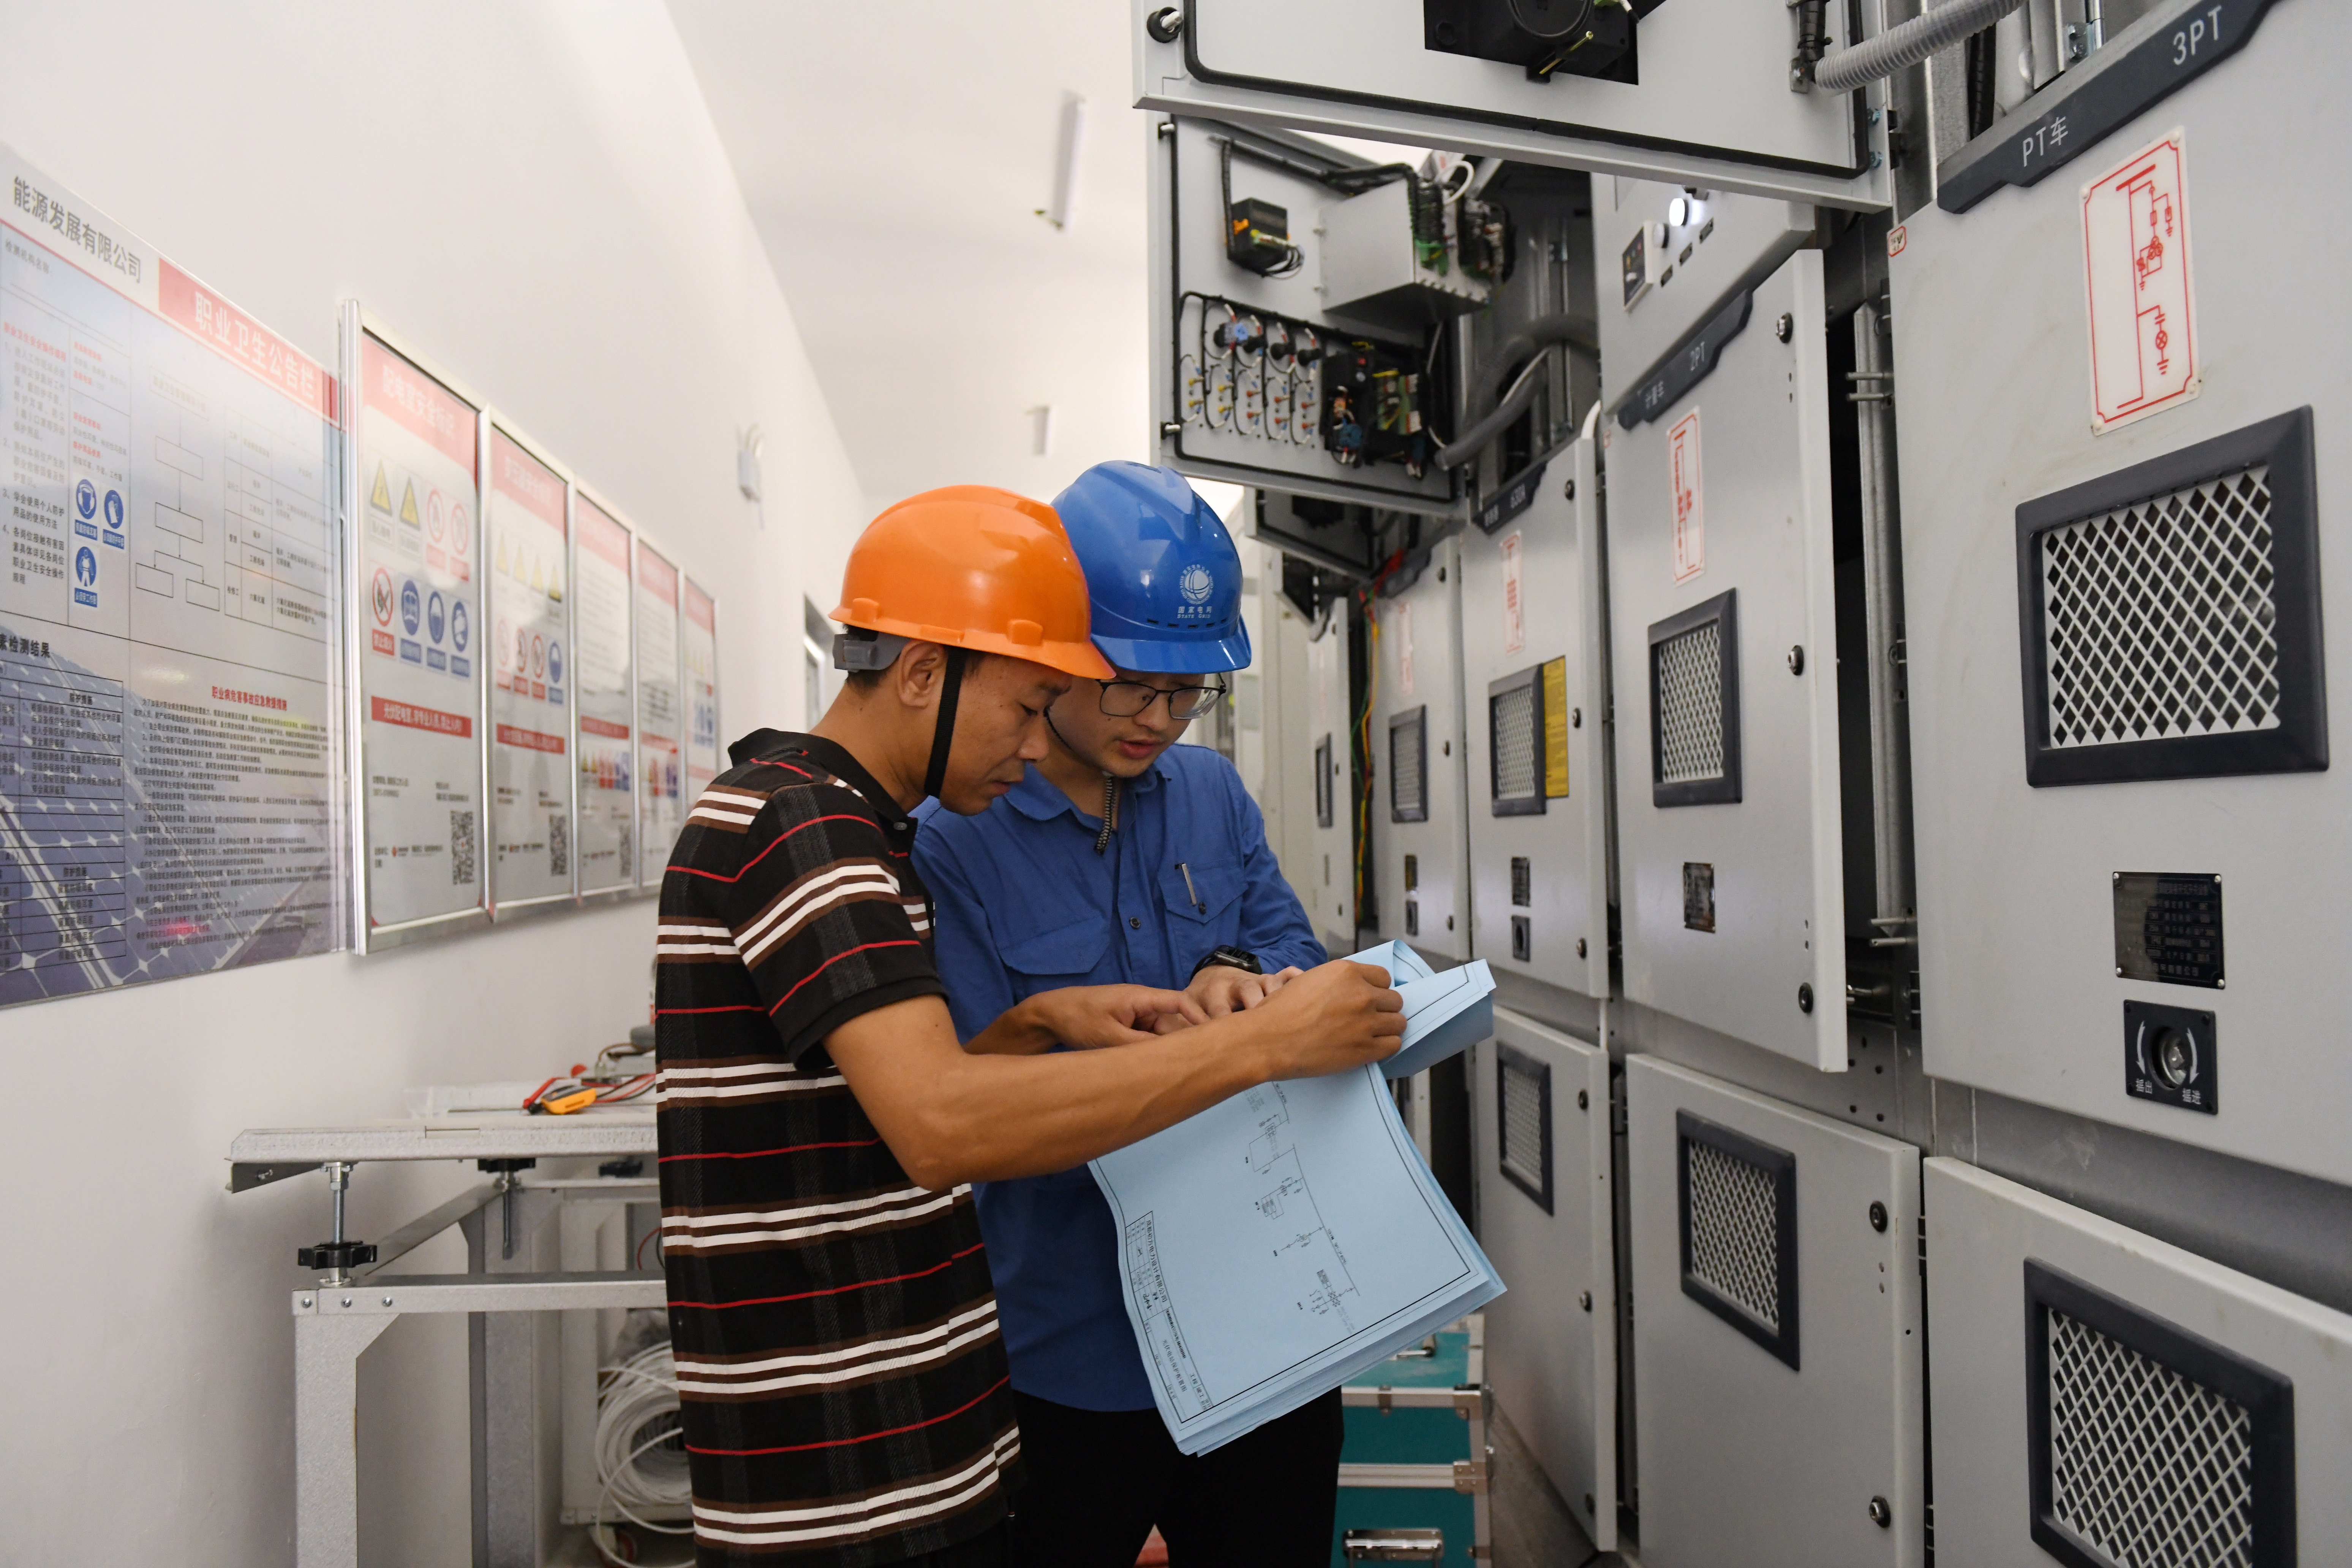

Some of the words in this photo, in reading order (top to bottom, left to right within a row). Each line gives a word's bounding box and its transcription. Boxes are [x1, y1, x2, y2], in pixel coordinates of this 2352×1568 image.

[2173, 6, 2221, 66] 3PT
[2023, 116, 2068, 167] PT车
[14, 175, 141, 284] 能源发展有限公司
[195, 291, 315, 401] 职业卫生公告栏
[1690, 341, 1705, 371] 2PT
